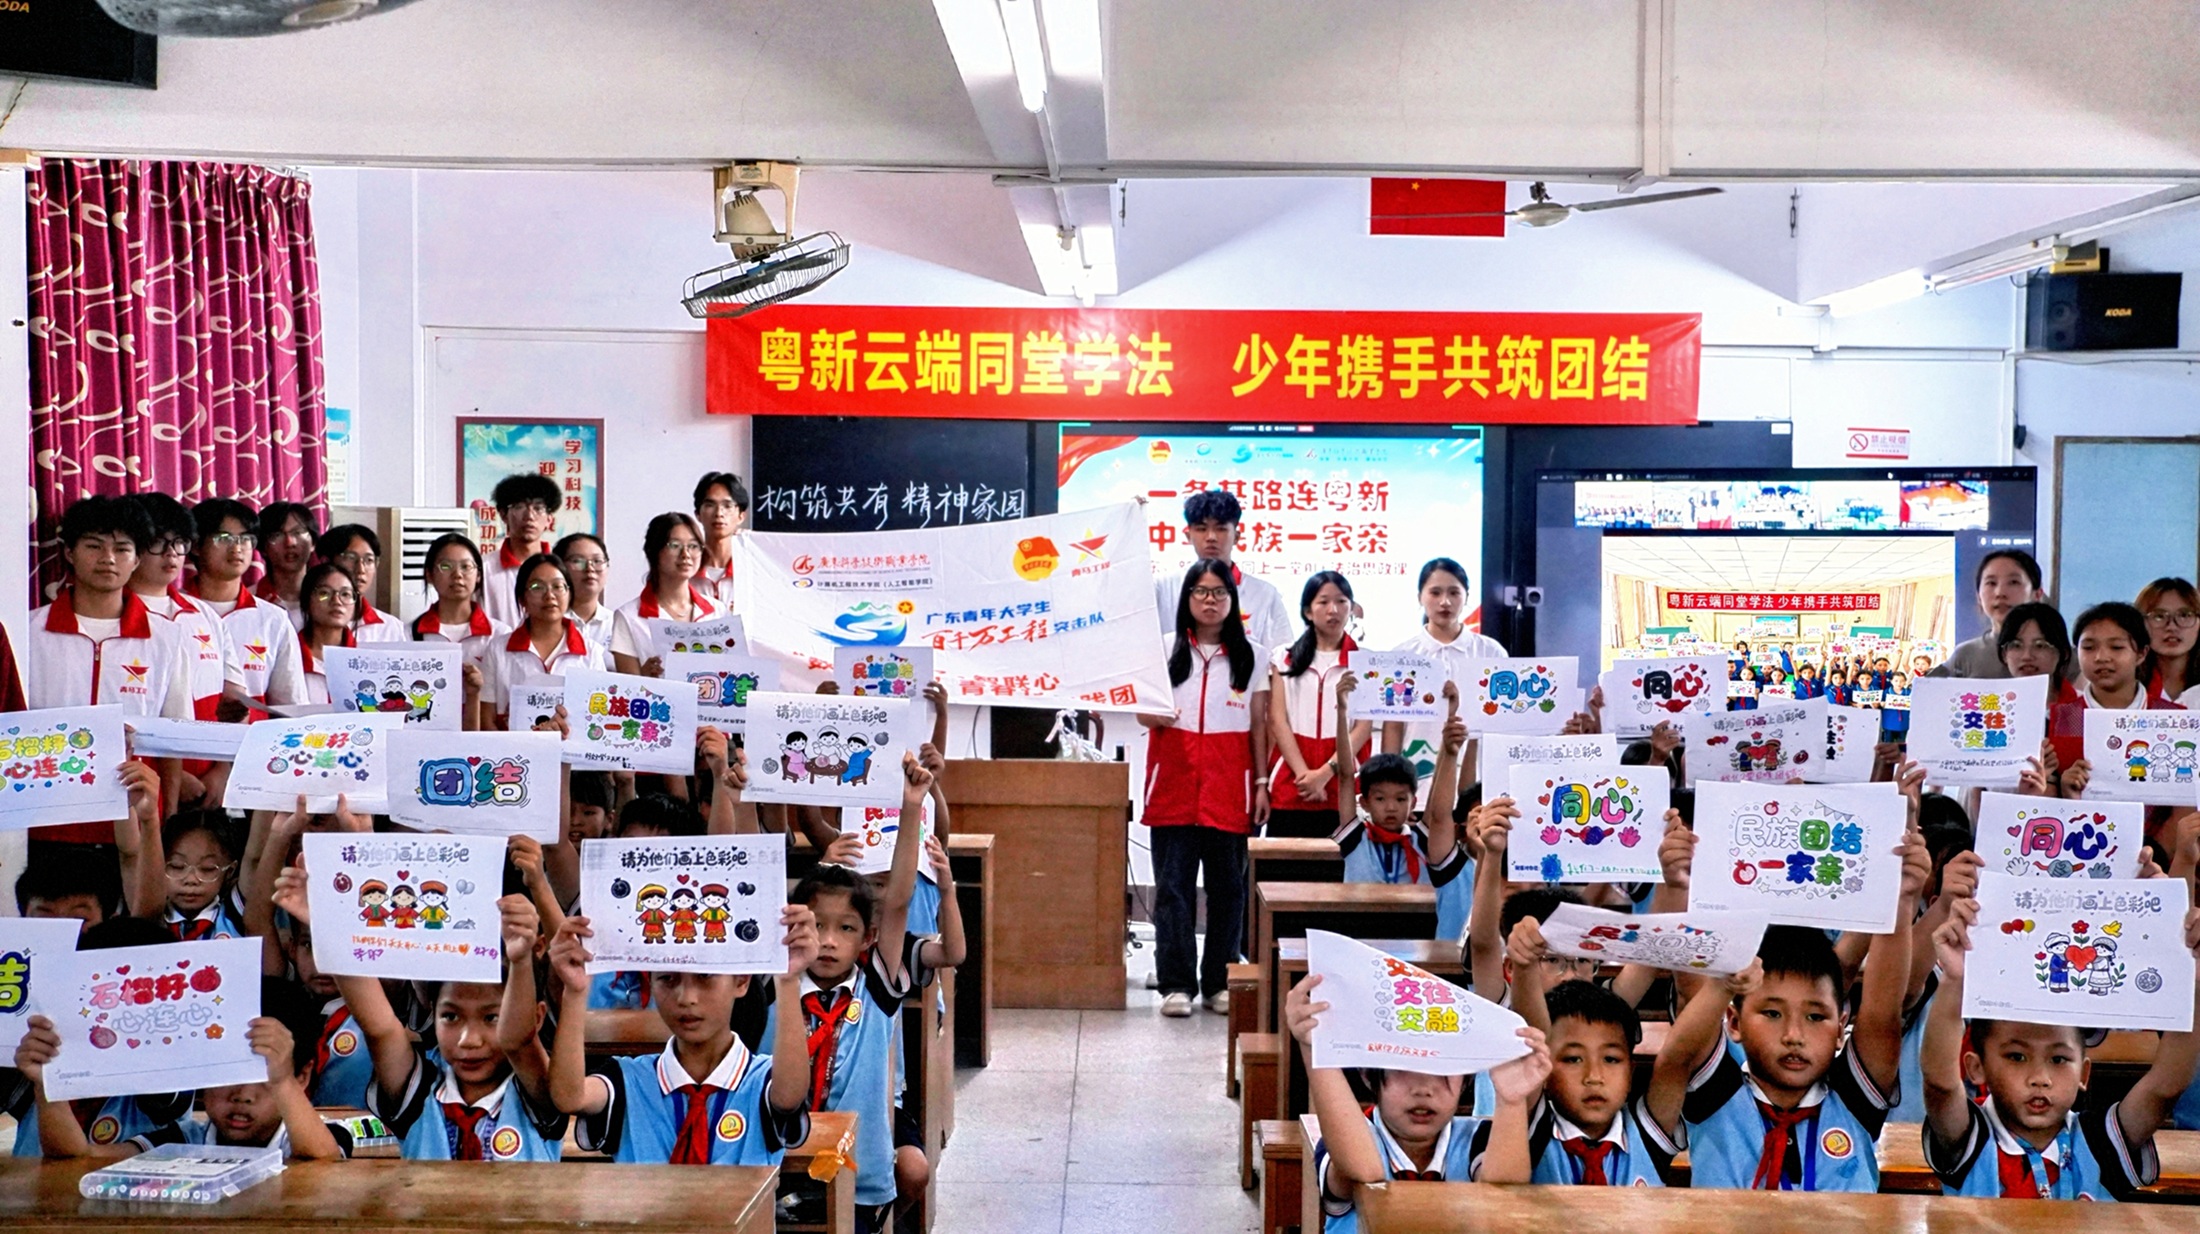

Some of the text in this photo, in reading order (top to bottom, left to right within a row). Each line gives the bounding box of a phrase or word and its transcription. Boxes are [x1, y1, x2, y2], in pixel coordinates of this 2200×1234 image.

[758, 327, 1651, 401] 粤新云端同堂学法 少年携手共筑团结
[565, 440, 582, 511] 学习科技
[757, 480, 1026, 530] 构筑共有 精神家园
[926, 600, 1051, 625] 广东青年大学生
[1668, 593, 1880, 609] 粤新云端同堂学法 少年携手共筑团结
[922, 611, 1106, 651] 百千万工程 突击队
[348, 658, 444, 672] 请为他们画上色彩吧
[1489, 670, 1551, 700] 同心
[1643, 670, 1703, 699] 同心
[588, 692, 671, 723] 民族团结
[775, 706, 888, 723] 请为他们画上色彩吧
[1960, 692, 2001, 711] 交流
[603, 719, 660, 742] 一家亲
[1963, 711, 2006, 729] 交往
[280, 732, 350, 748] 石榴籽
[1964, 729, 2008, 748] 交融
[289, 749, 363, 768] 心连心
[1508, 746, 1602, 760] 请为他们画上色彩吧
[4, 756, 88, 779] 心连心
[420, 757, 529, 806] 团结
[1551, 783, 1634, 825] 同心
[1735, 813, 1864, 855] 民族团结
[2020, 816, 2109, 861] 同心
[341, 845, 470, 864] 请为他们画上色彩吧
[620, 850, 748, 869] 请为他们画上色彩吧
[1758, 850, 1845, 886] 一家亲
[2014, 890, 2162, 913] 请为他们画上色彩吧
[89, 973, 189, 1010] 石榴籽
[1394, 977, 1456, 1005] 交往
[111, 1003, 213, 1034] 心连心
[1396, 1005, 1460, 1033] 交融
